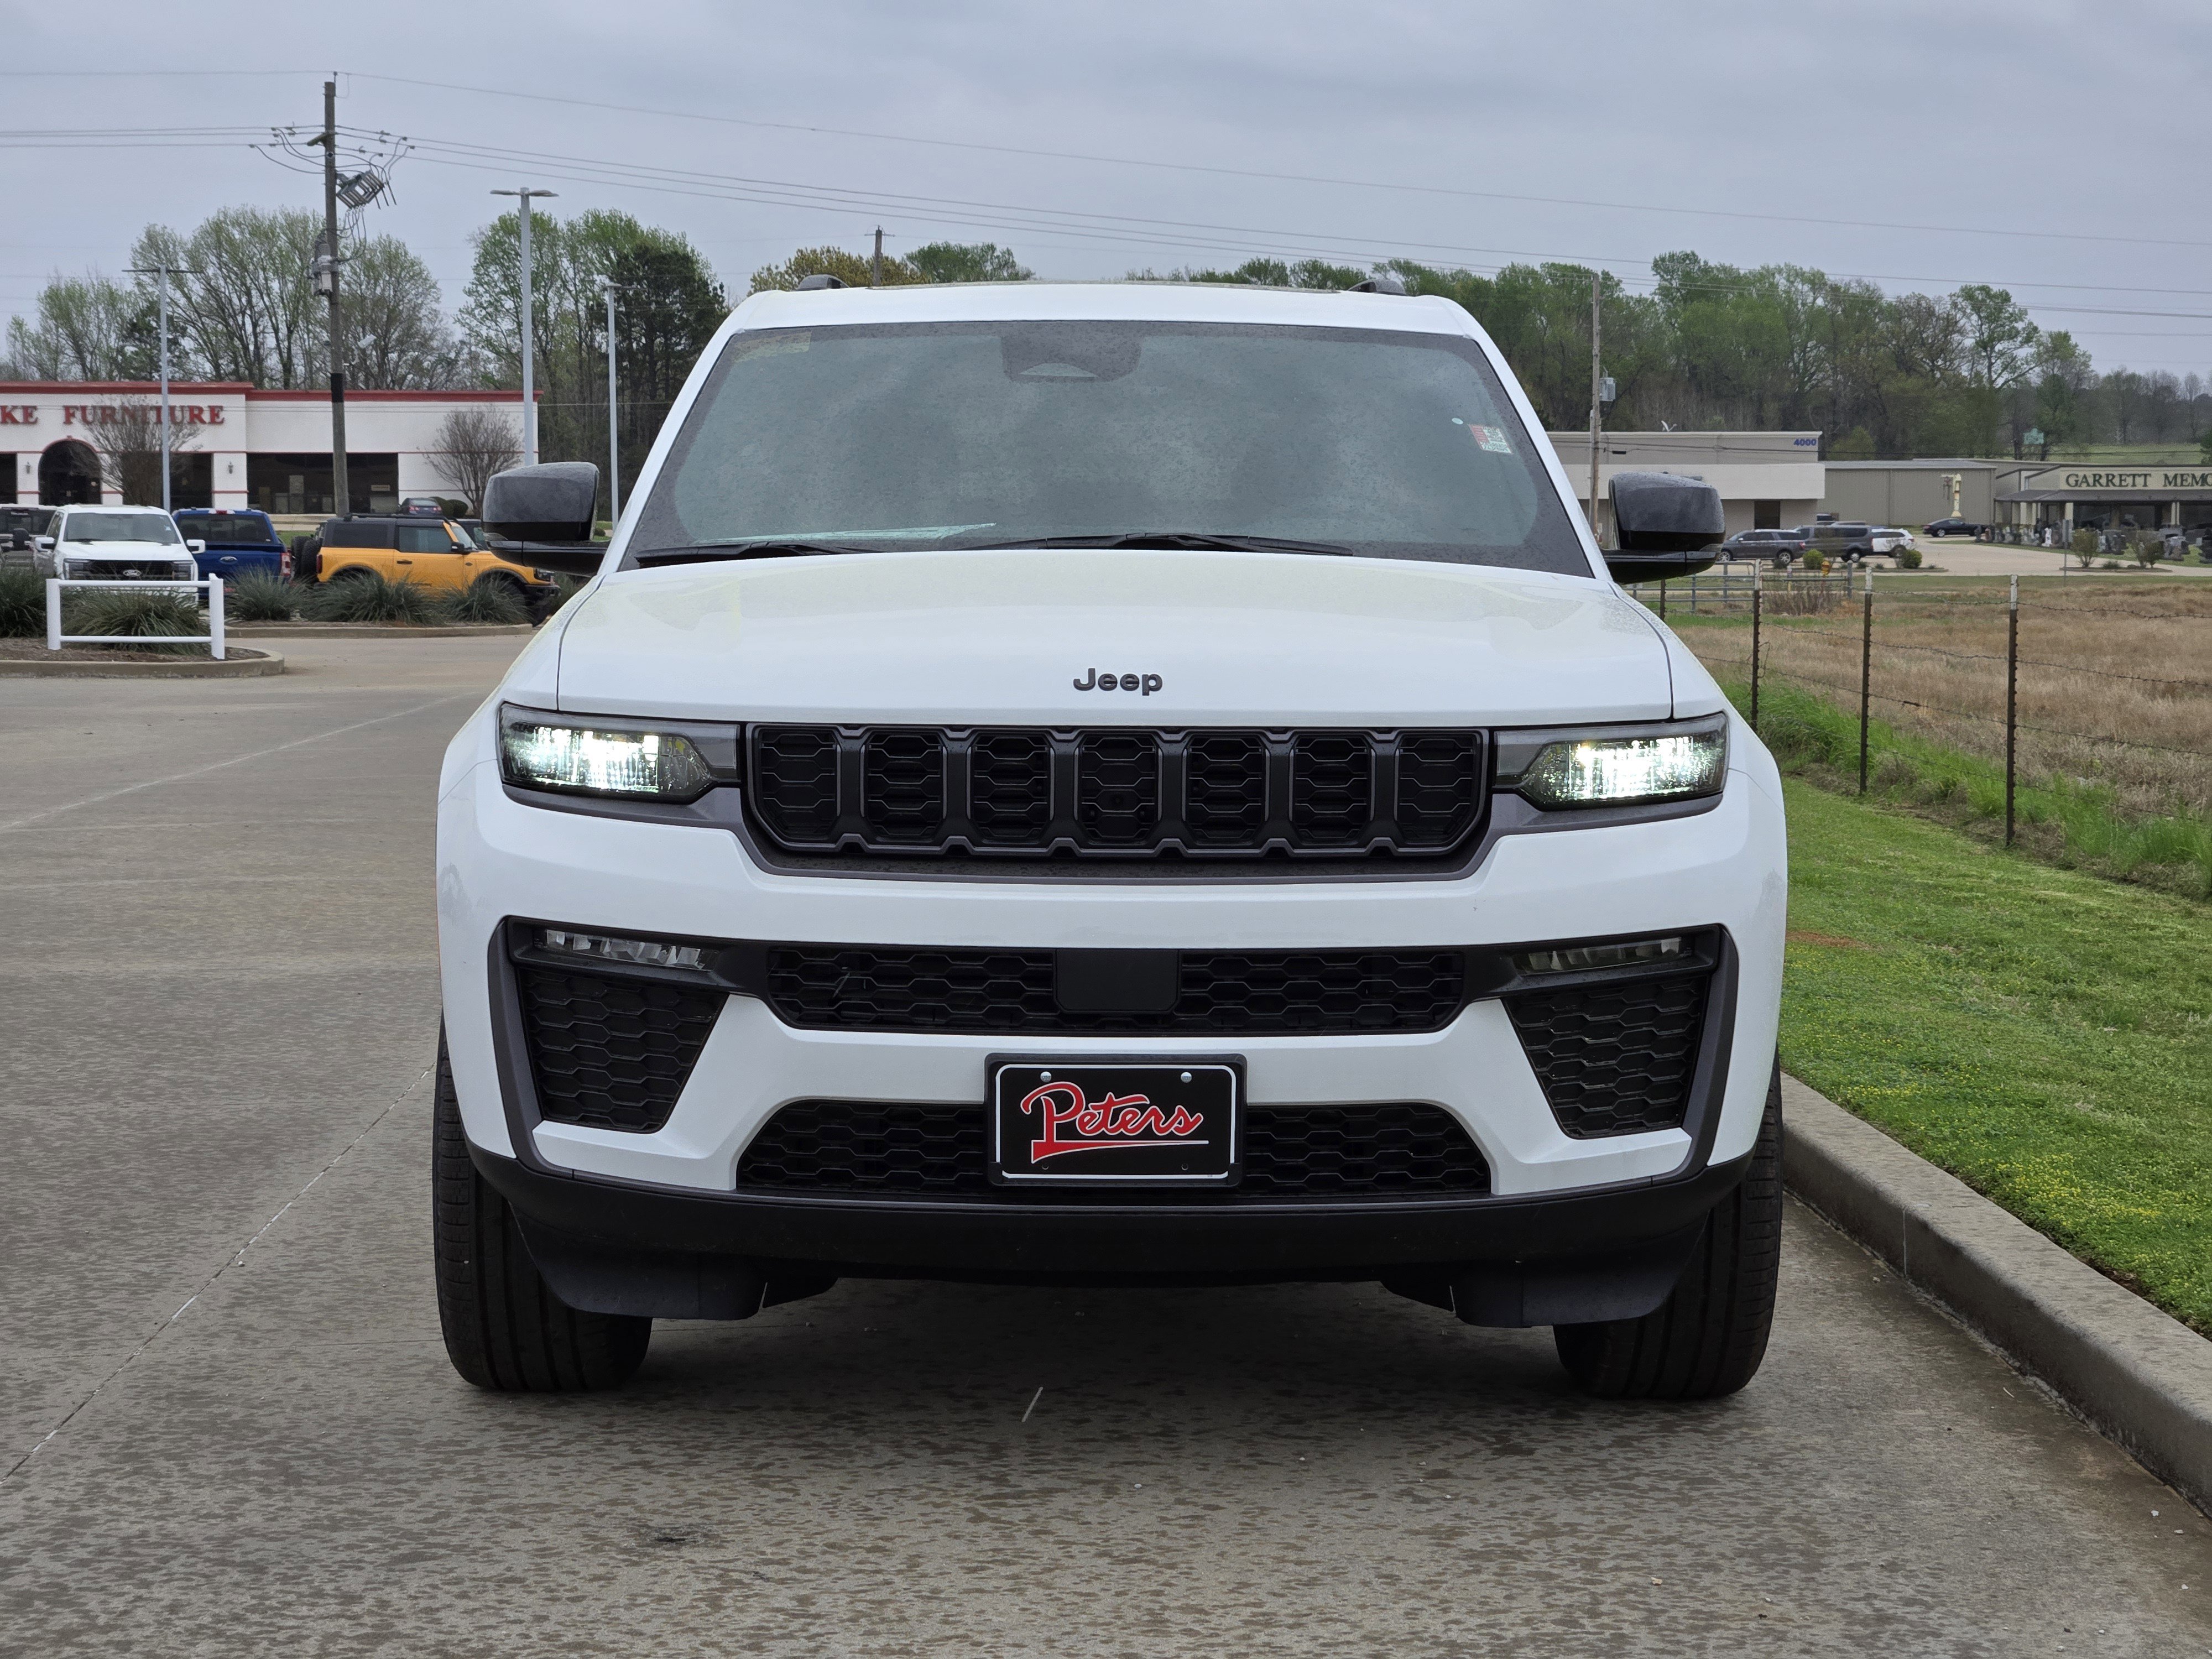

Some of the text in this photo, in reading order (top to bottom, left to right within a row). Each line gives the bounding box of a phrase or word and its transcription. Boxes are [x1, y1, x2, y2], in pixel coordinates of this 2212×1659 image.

[63, 405, 225, 424] FURNITURE
[2065, 473, 2151, 487] GARRETT
[1073, 668, 1163, 696] Jeep
[1020, 1081, 1203, 1164] Peters
